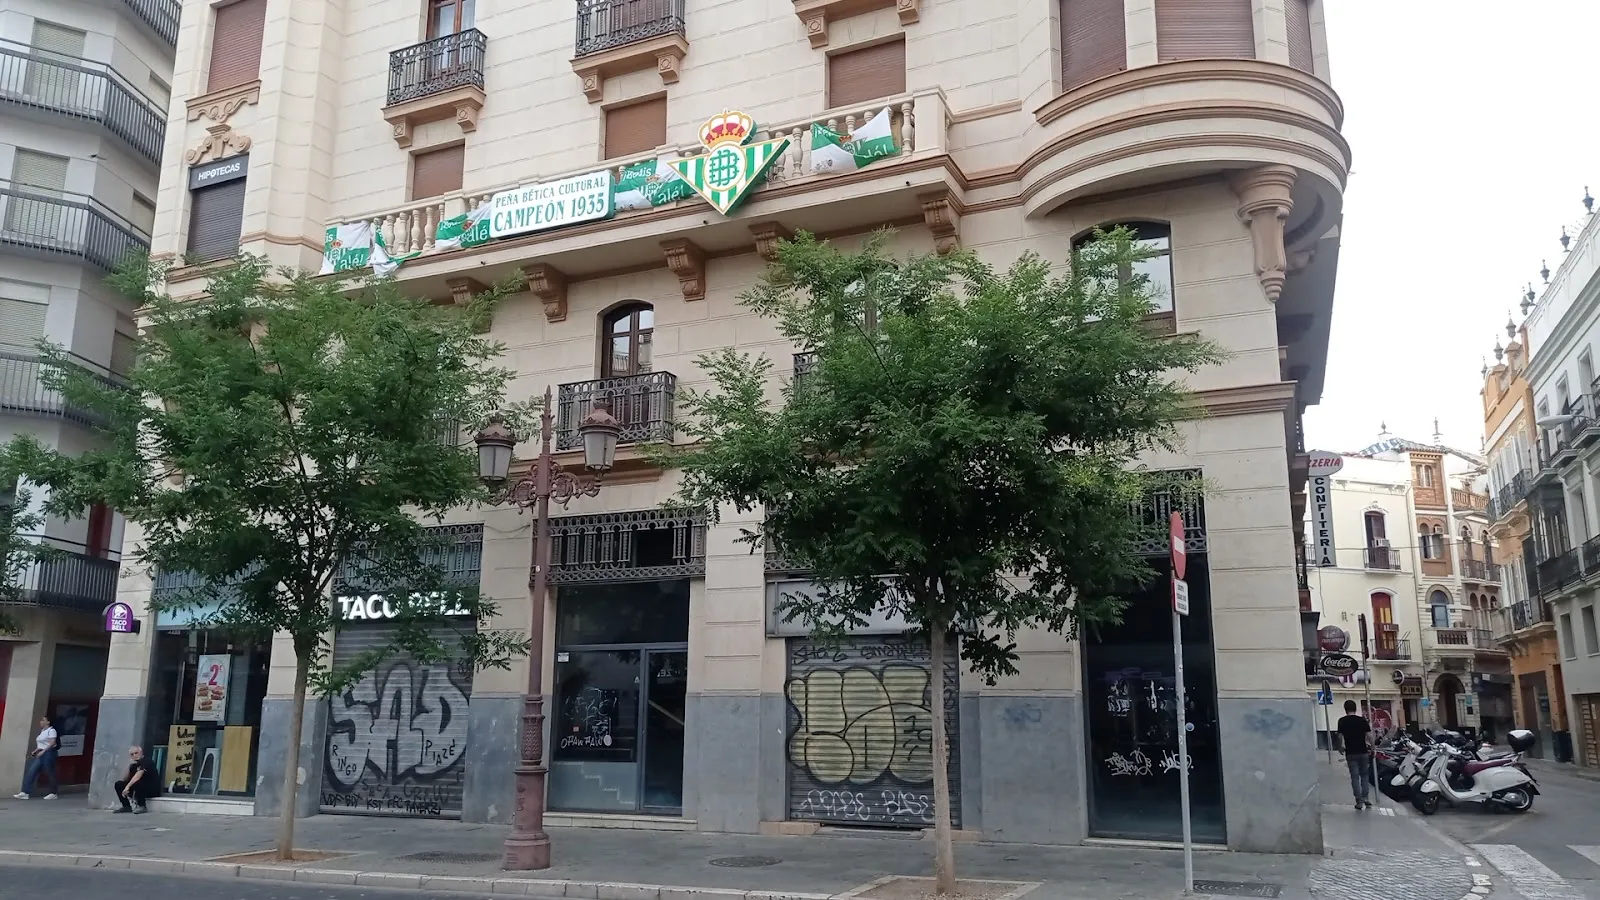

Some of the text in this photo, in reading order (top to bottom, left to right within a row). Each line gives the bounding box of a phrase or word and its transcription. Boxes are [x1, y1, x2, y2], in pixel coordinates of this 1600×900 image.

[198, 163, 241, 181] HIPOTECAS
[496, 175, 606, 208] PEÑA BÉTICA CULTURAL
[494, 192, 605, 232] CAMPEÓN 1935
[1314, 477, 1332, 566] CONFITERIA
